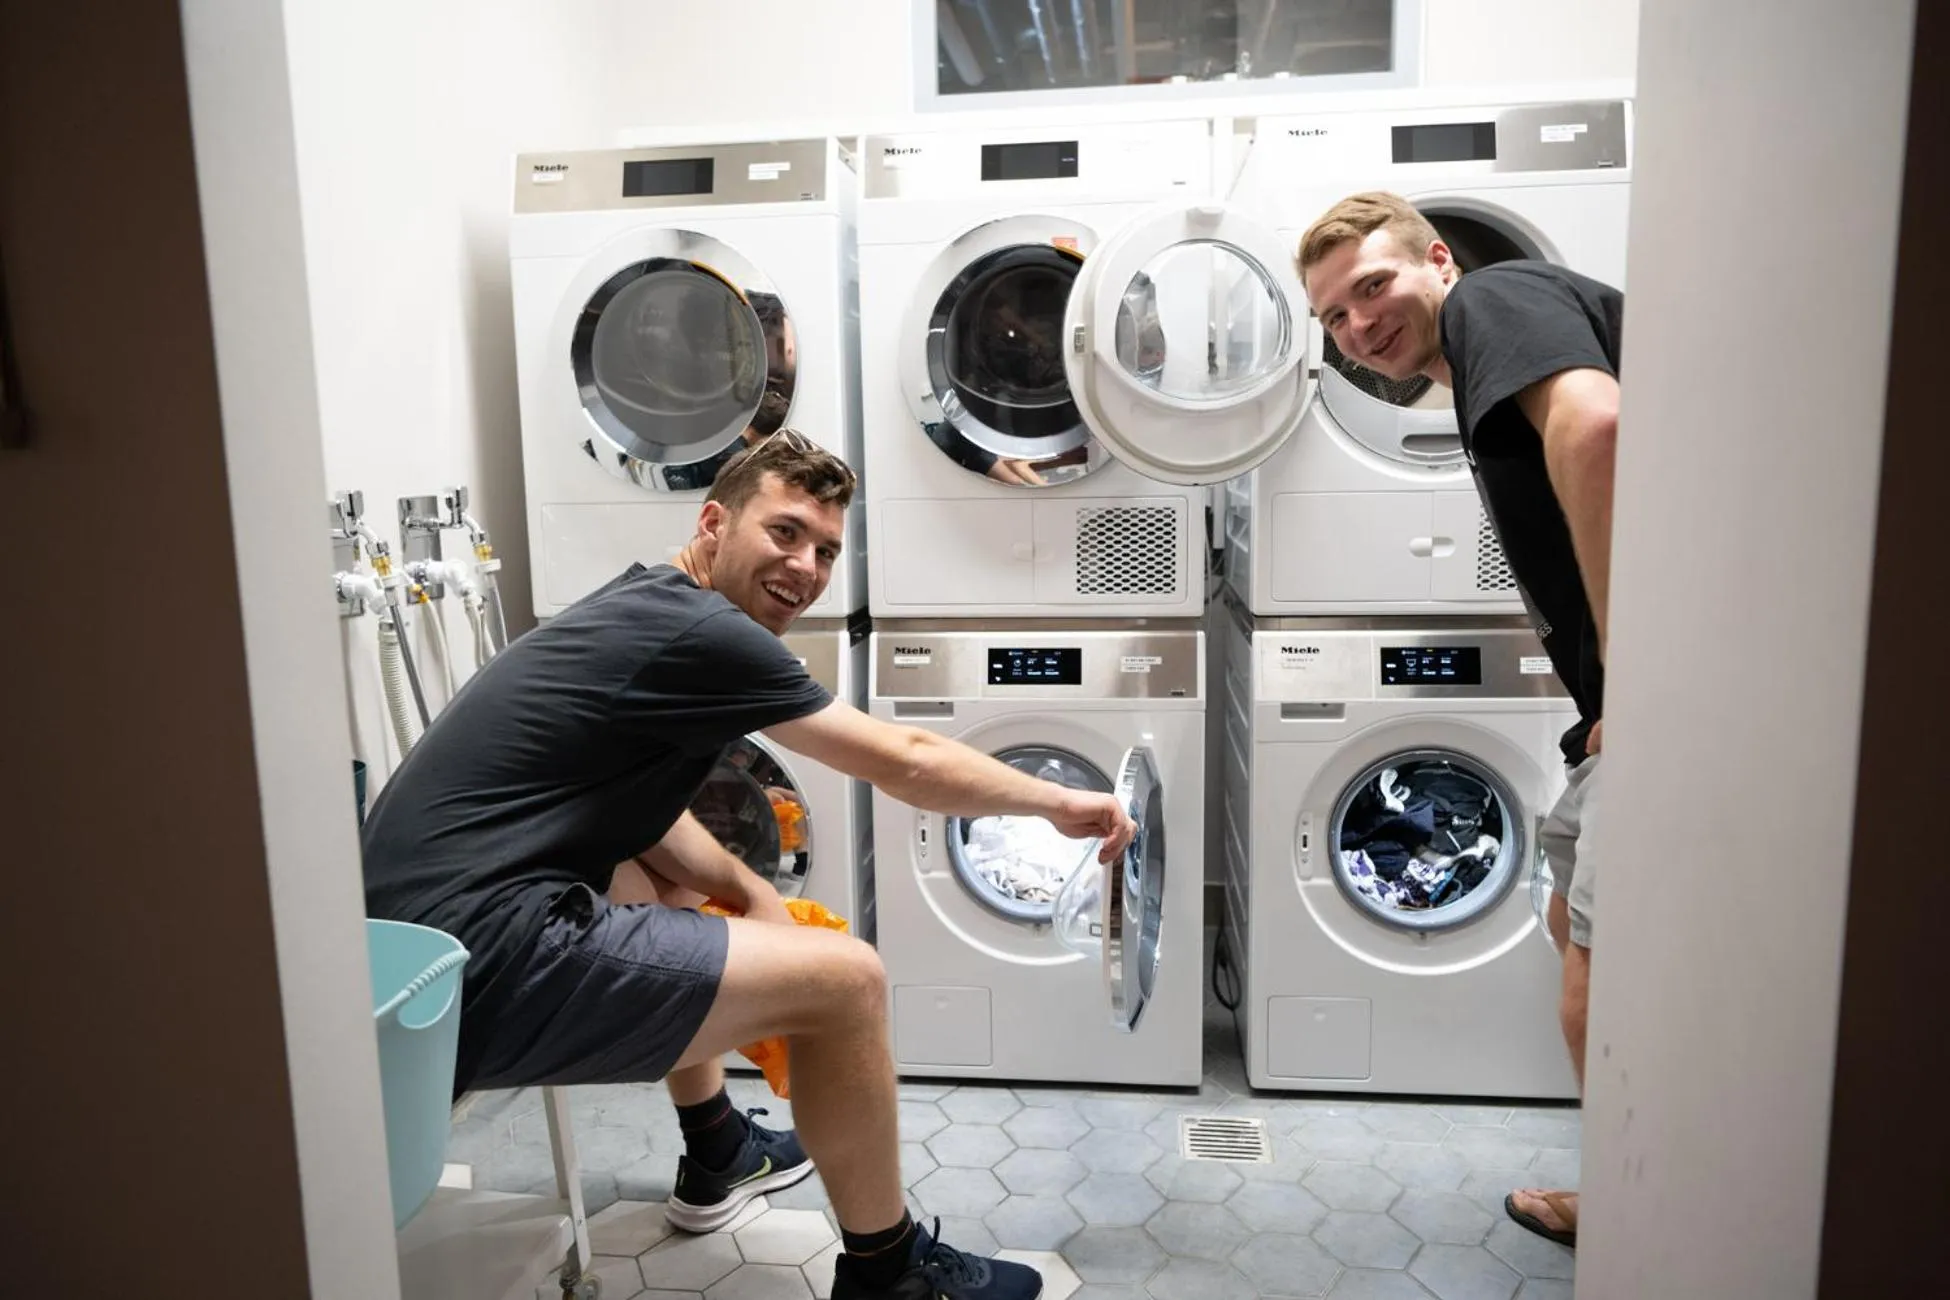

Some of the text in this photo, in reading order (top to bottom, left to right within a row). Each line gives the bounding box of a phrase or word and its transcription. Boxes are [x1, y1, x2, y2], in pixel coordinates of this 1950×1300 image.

[1287, 128, 1328, 136] Miele
[884, 147, 923, 156] Miele
[533, 164, 569, 172] Miele
[894, 646, 931, 655] Miele
[1281, 646, 1320, 654] Miele
